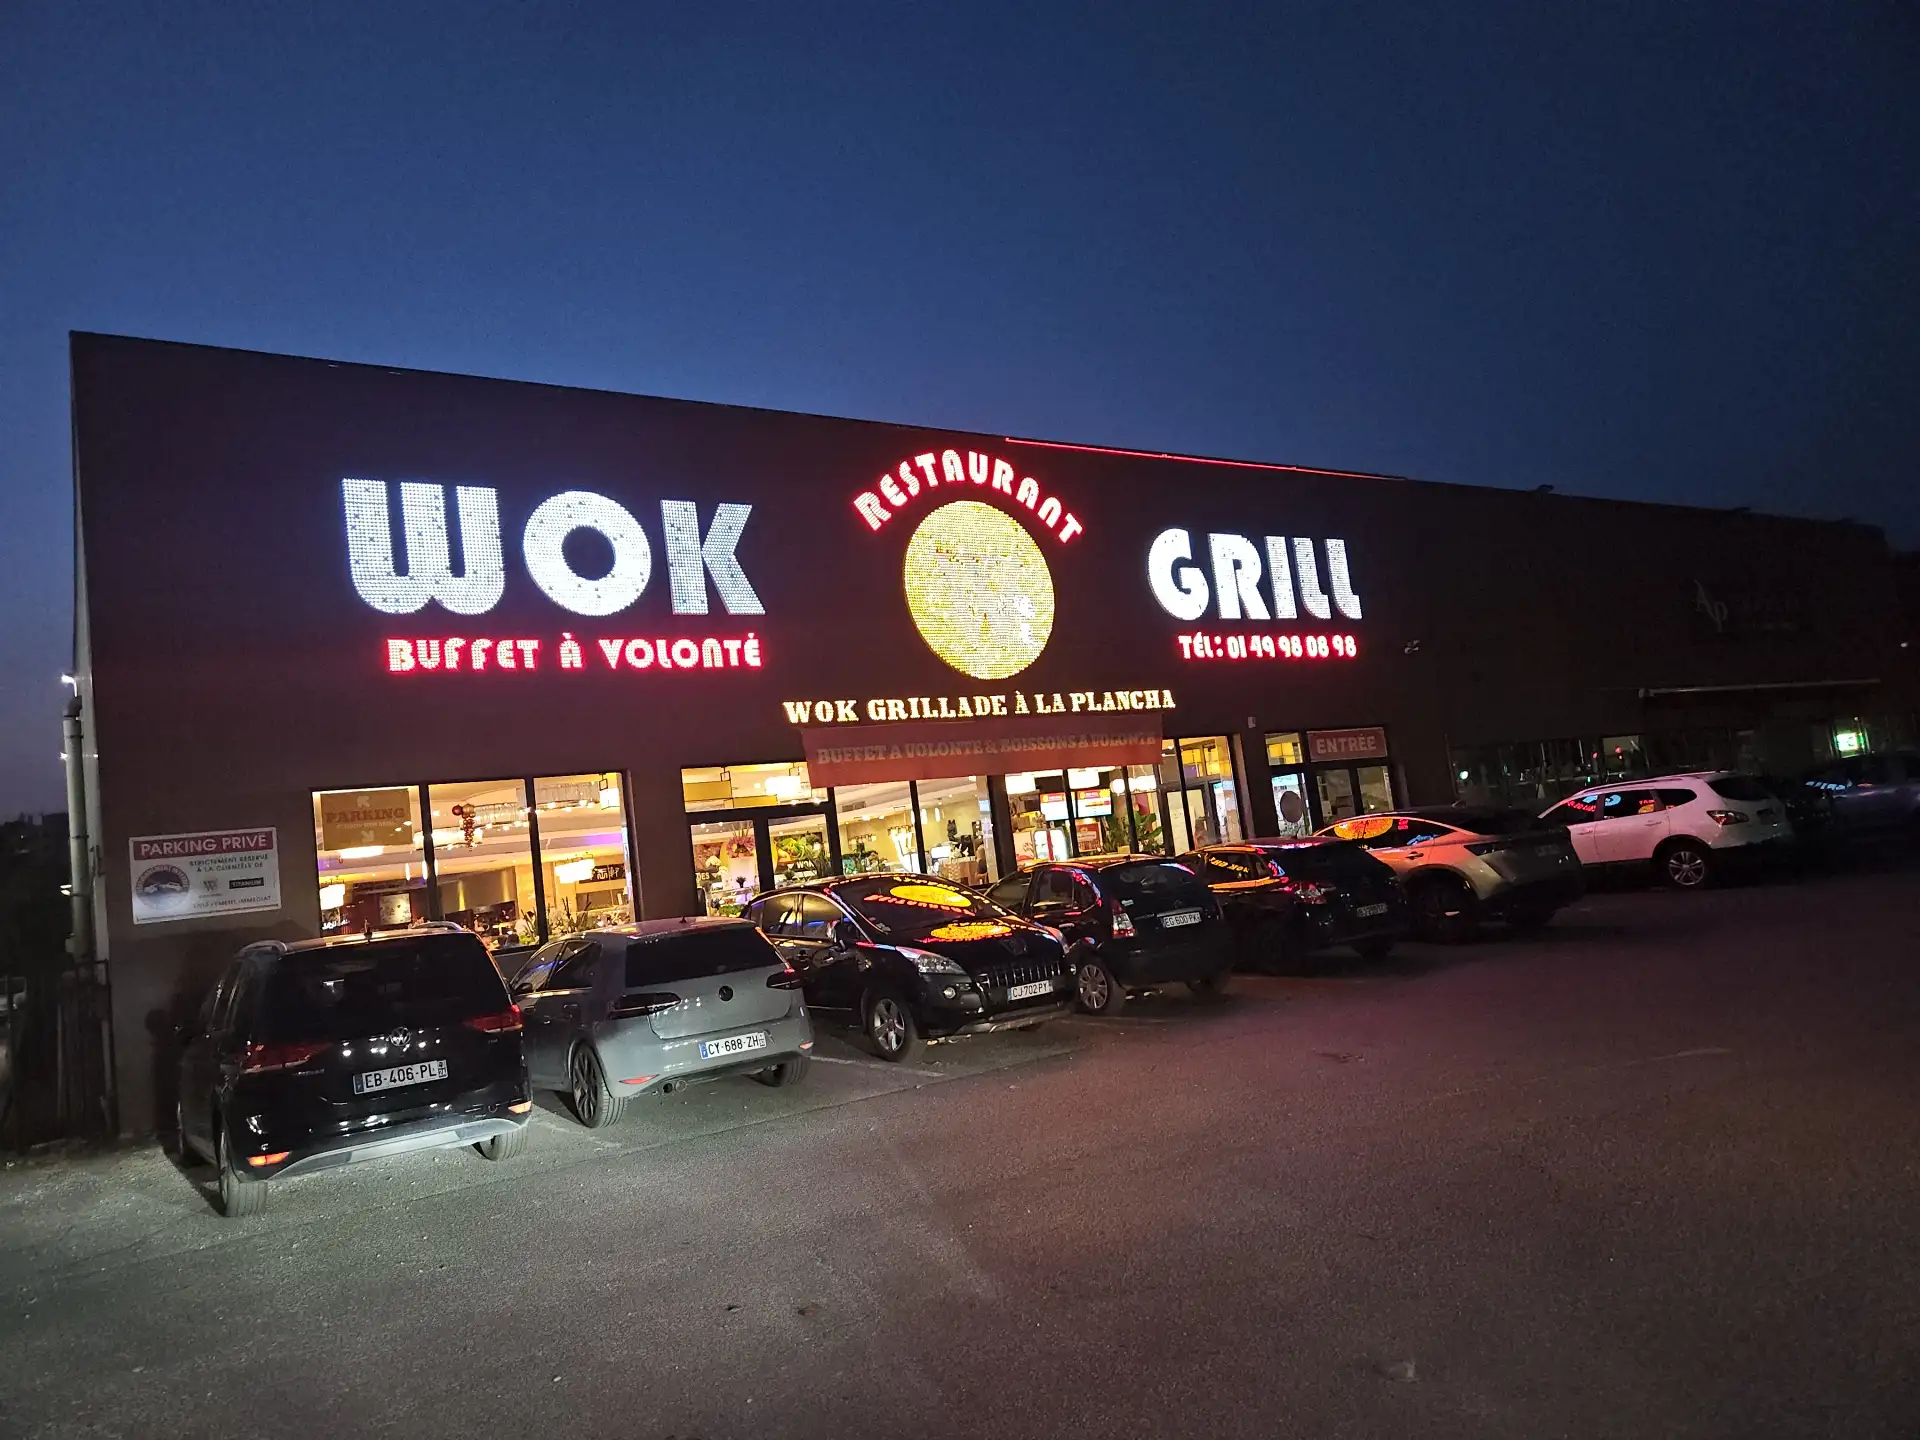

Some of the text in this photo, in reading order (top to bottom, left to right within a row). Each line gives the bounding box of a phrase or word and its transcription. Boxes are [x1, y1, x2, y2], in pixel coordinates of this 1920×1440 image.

[853, 448, 1084, 544] RESTAURANT
[341, 477, 767, 616] WOK
[1148, 527, 1363, 621] GRILL
[386, 632, 764, 673] BUFFET À VOLONTÉ
[1226, 635, 1248, 660] 01
[1249, 635, 1276, 658] 49
[1278, 635, 1303, 658] 98
[1305, 635, 1330, 658] 08
[1331, 635, 1357, 658] 98
[783, 689, 1177, 725] WOK GRILLADE À LA PLANCHA
[817, 745, 887, 765] BUFFET
[1000, 733, 1076, 753] BOISSONS
[1316, 733, 1377, 754] ENTRÉE
[324, 807, 406, 824] PARKING
[140, 838, 217, 857] PARKING
[708, 1035, 760, 1055] CY-688-ZH
[364, 1064, 437, 1089] EB-406-PL
